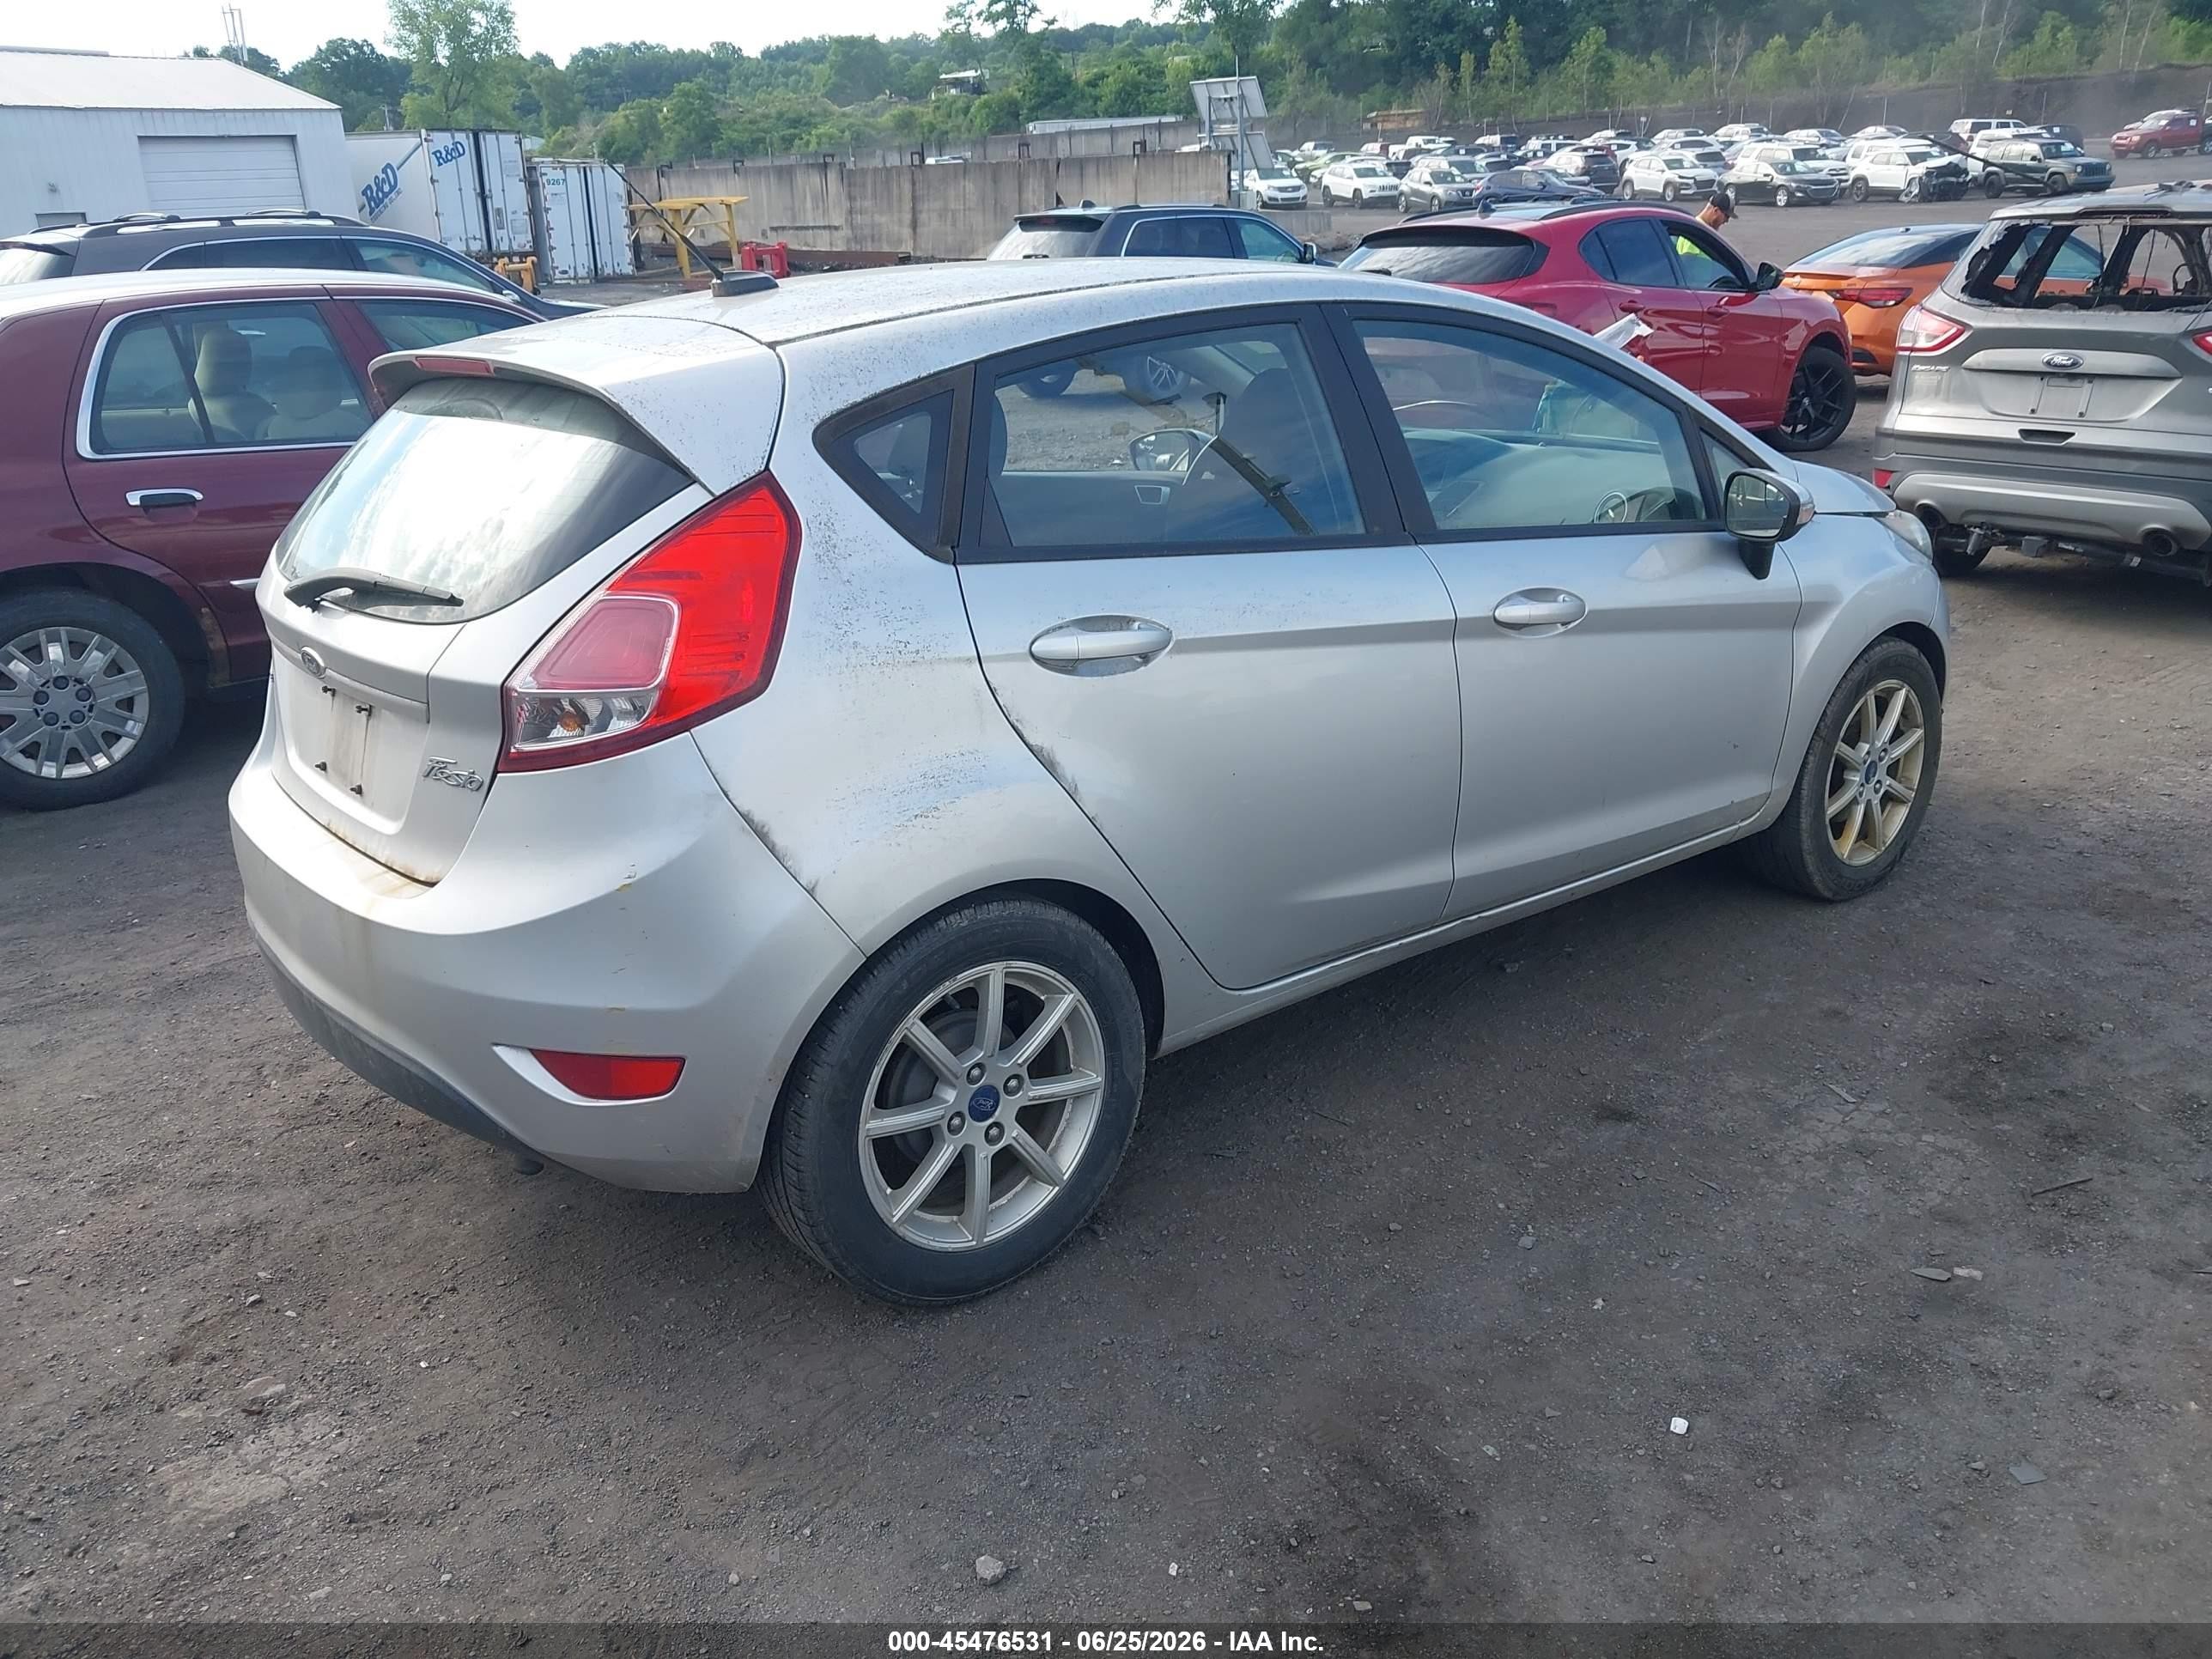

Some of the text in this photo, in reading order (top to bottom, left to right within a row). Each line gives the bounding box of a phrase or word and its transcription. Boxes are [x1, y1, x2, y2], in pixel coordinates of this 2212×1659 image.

[432, 141, 465, 167] R&D
[362, 162, 398, 216] R&D
[422, 756, 483, 791] Fiesta
